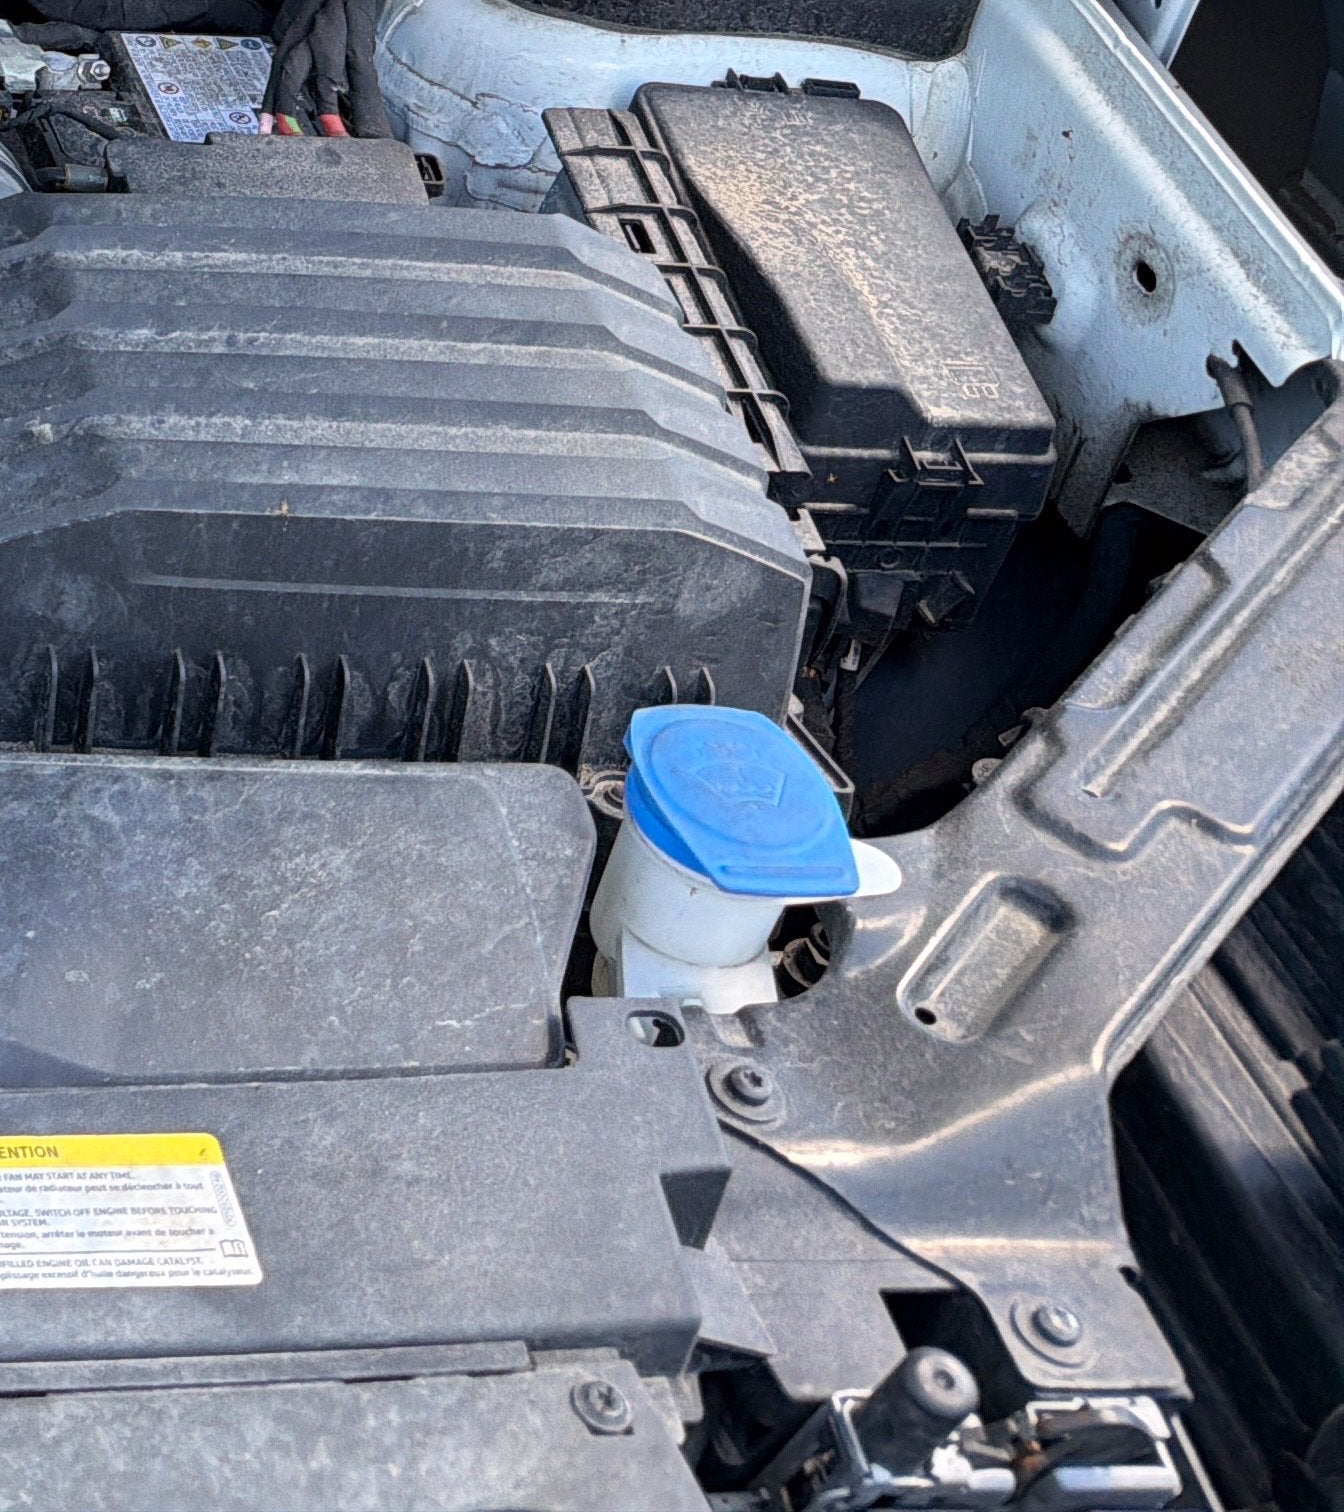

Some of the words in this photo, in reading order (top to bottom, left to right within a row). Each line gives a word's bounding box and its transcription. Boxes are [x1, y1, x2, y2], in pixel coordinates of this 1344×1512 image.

[3, 1172, 23, 1181] FAN
[24, 1172, 44, 1181] MAY
[45, 1171, 74, 1180] START
[76, 1171, 87, 1179] AT
[89, 1171, 108, 1179] ANY
[24, 1184, 38, 1193] de
[39, 1183, 83, 1193] radiateur
[84, 1183, 108, 1194] peut
[108, 1184, 121, 1192] se
[183, 1182, 205, 1190] tout
[34, 1208, 72, 1217] SWITCH
[72, 1207, 91, 1216] OFF
[93, 1207, 129, 1216] ENGINE
[130, 1207, 167, 1215] BEFORE
[168, 1206, 218, 1215] TOUCHING
[124, 1228, 153, 1237] avant
[155, 1228, 167, 1237] de
[168, 1227, 206, 1237] toucher
